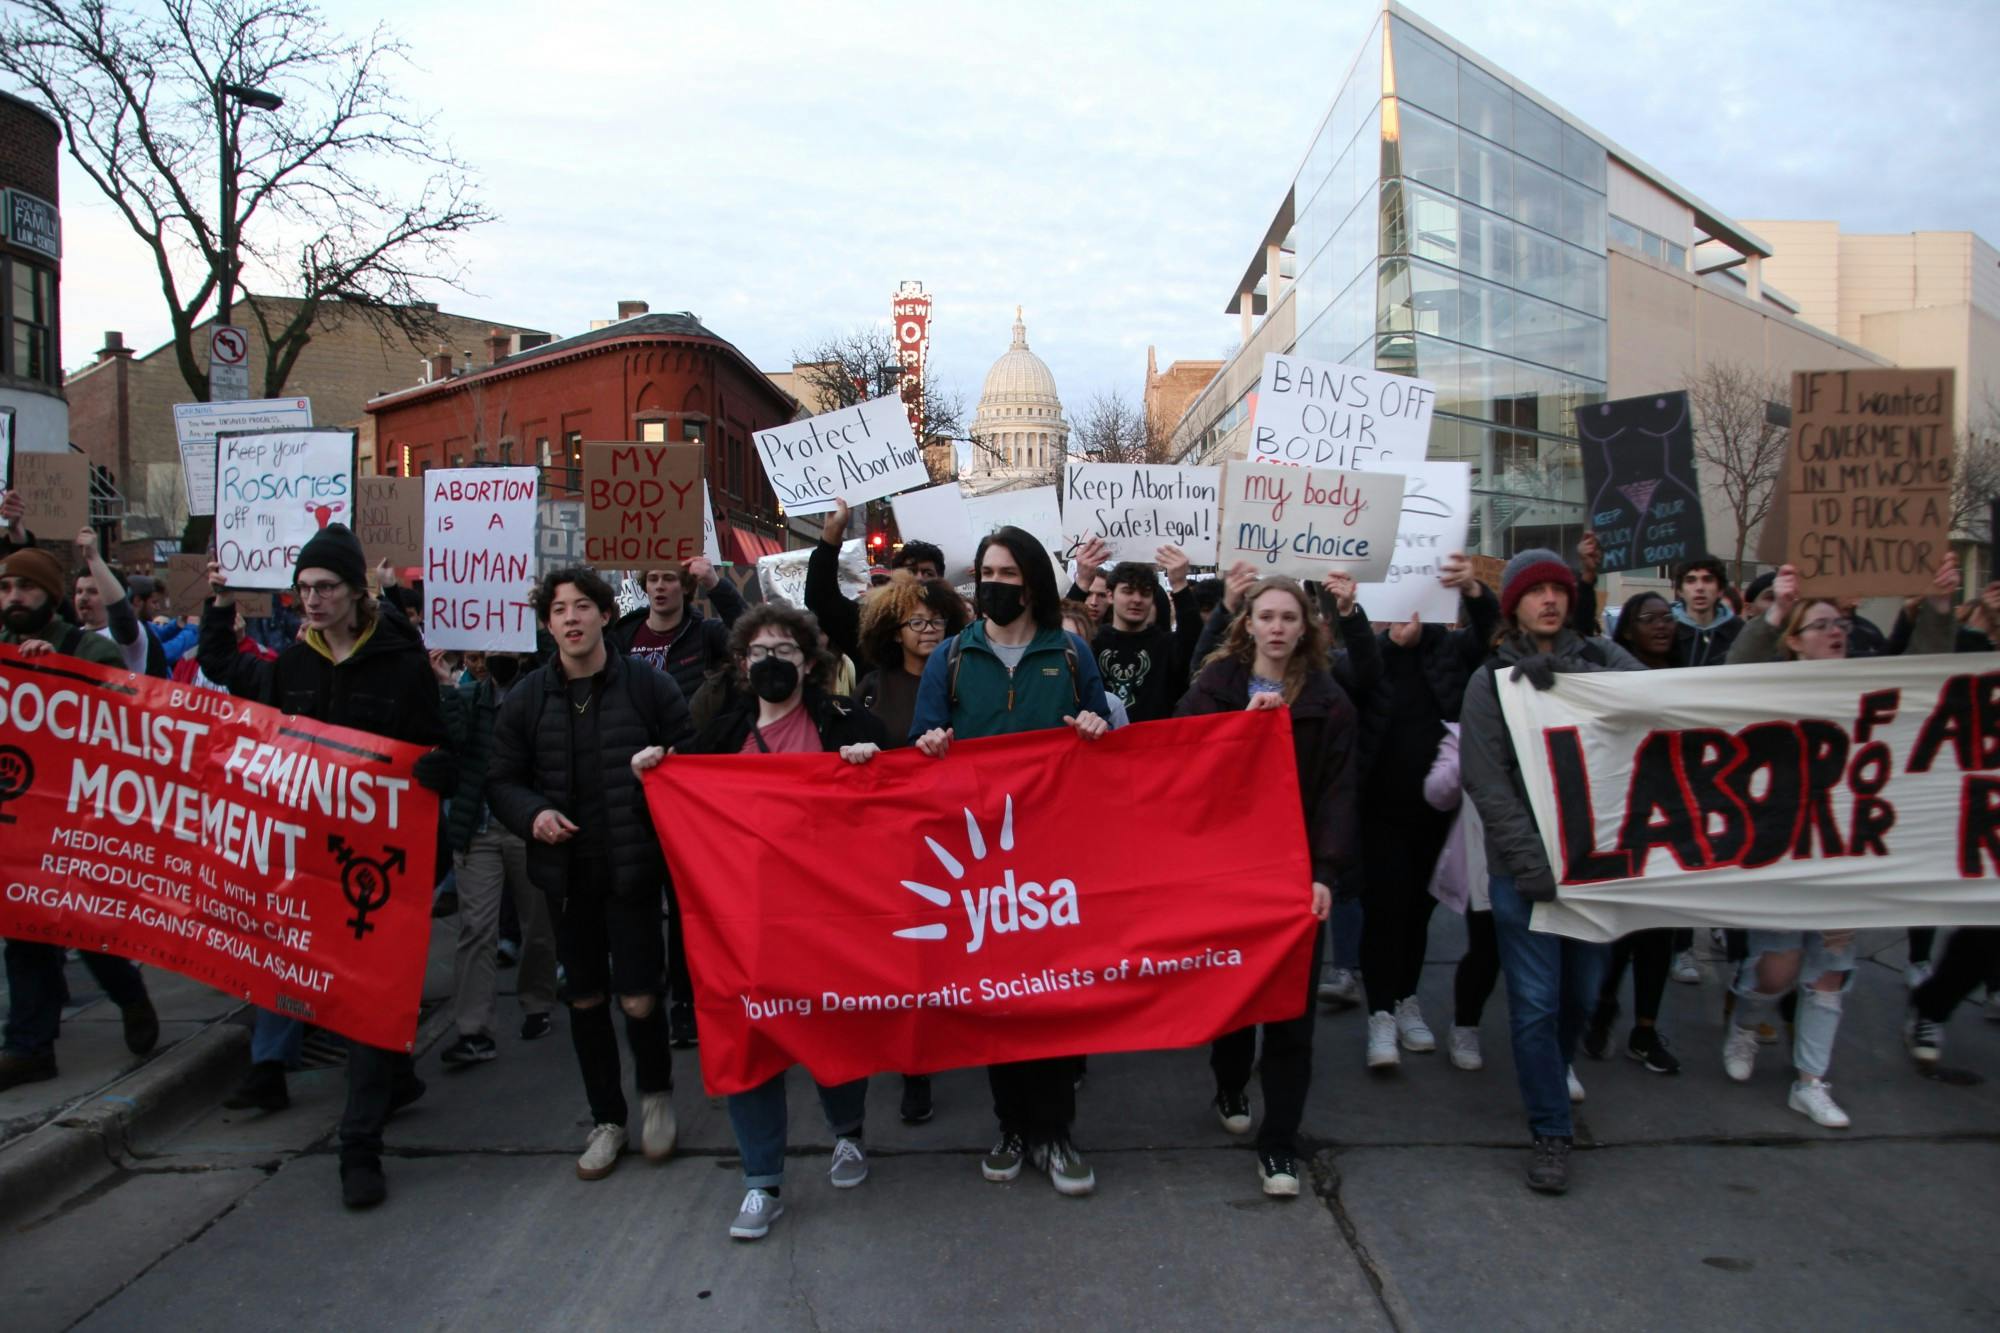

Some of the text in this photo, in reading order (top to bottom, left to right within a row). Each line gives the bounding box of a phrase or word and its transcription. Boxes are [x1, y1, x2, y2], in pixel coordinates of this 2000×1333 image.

[894, 304, 927, 316] NEW
[1273, 360, 1436, 420] BANS OFF
[1797, 372, 1944, 416] IF I wanted
[760, 407, 872, 468] Protect
[1302, 403, 1377, 445] OUR
[1797, 422, 1944, 463] GOVERMENT
[227, 440, 309, 468] Keep your
[612, 446, 668, 477] MY
[771, 441, 921, 505] Safe Abortion
[1802, 456, 1952, 493] IN MY WOMB
[224, 466, 347, 503] Rosaries
[434, 479, 535, 502] ABORTION
[590, 479, 694, 511] BODY
[1069, 466, 1215, 509] Keep Abortion
[1244, 474, 1293, 522] my
[257, 513, 275, 542] my
[437, 513, 504, 532] IS A
[621, 509, 666, 535] MY
[1647, 521, 1678, 540] OFF
[1851, 496, 1909, 529] FUCK
[1920, 496, 1941, 527] A
[585, 535, 695, 561] CHOICE
[1238, 522, 1370, 565] my choice
[1602, 541, 1686, 569] MY BODY
[1799, 531, 1938, 580] SENATOR
[428, 547, 528, 584] HUMAN
[431, 597, 531, 632] RIGHT
[169, 688, 253, 728] BUILD A
[224, 736, 410, 830] FEMINIST
[1543, 719, 1851, 886] LABOR
[1848, 687, 1902, 857] FOR
[66, 758, 307, 881] MOVEMENT
[51, 826, 312, 922] MEDICARE FOR ALL WITH FULL
[40, 853, 192, 904] REPRODUCTIVE
[263, 920, 313, 953] CARE
[960, 869, 1081, 954] ydsa
[6, 882, 335, 994] ORGANIZE AGAINST SEXUAL ASSAULT
[740, 947, 1243, 1020] Young Democratic Socialists of America
